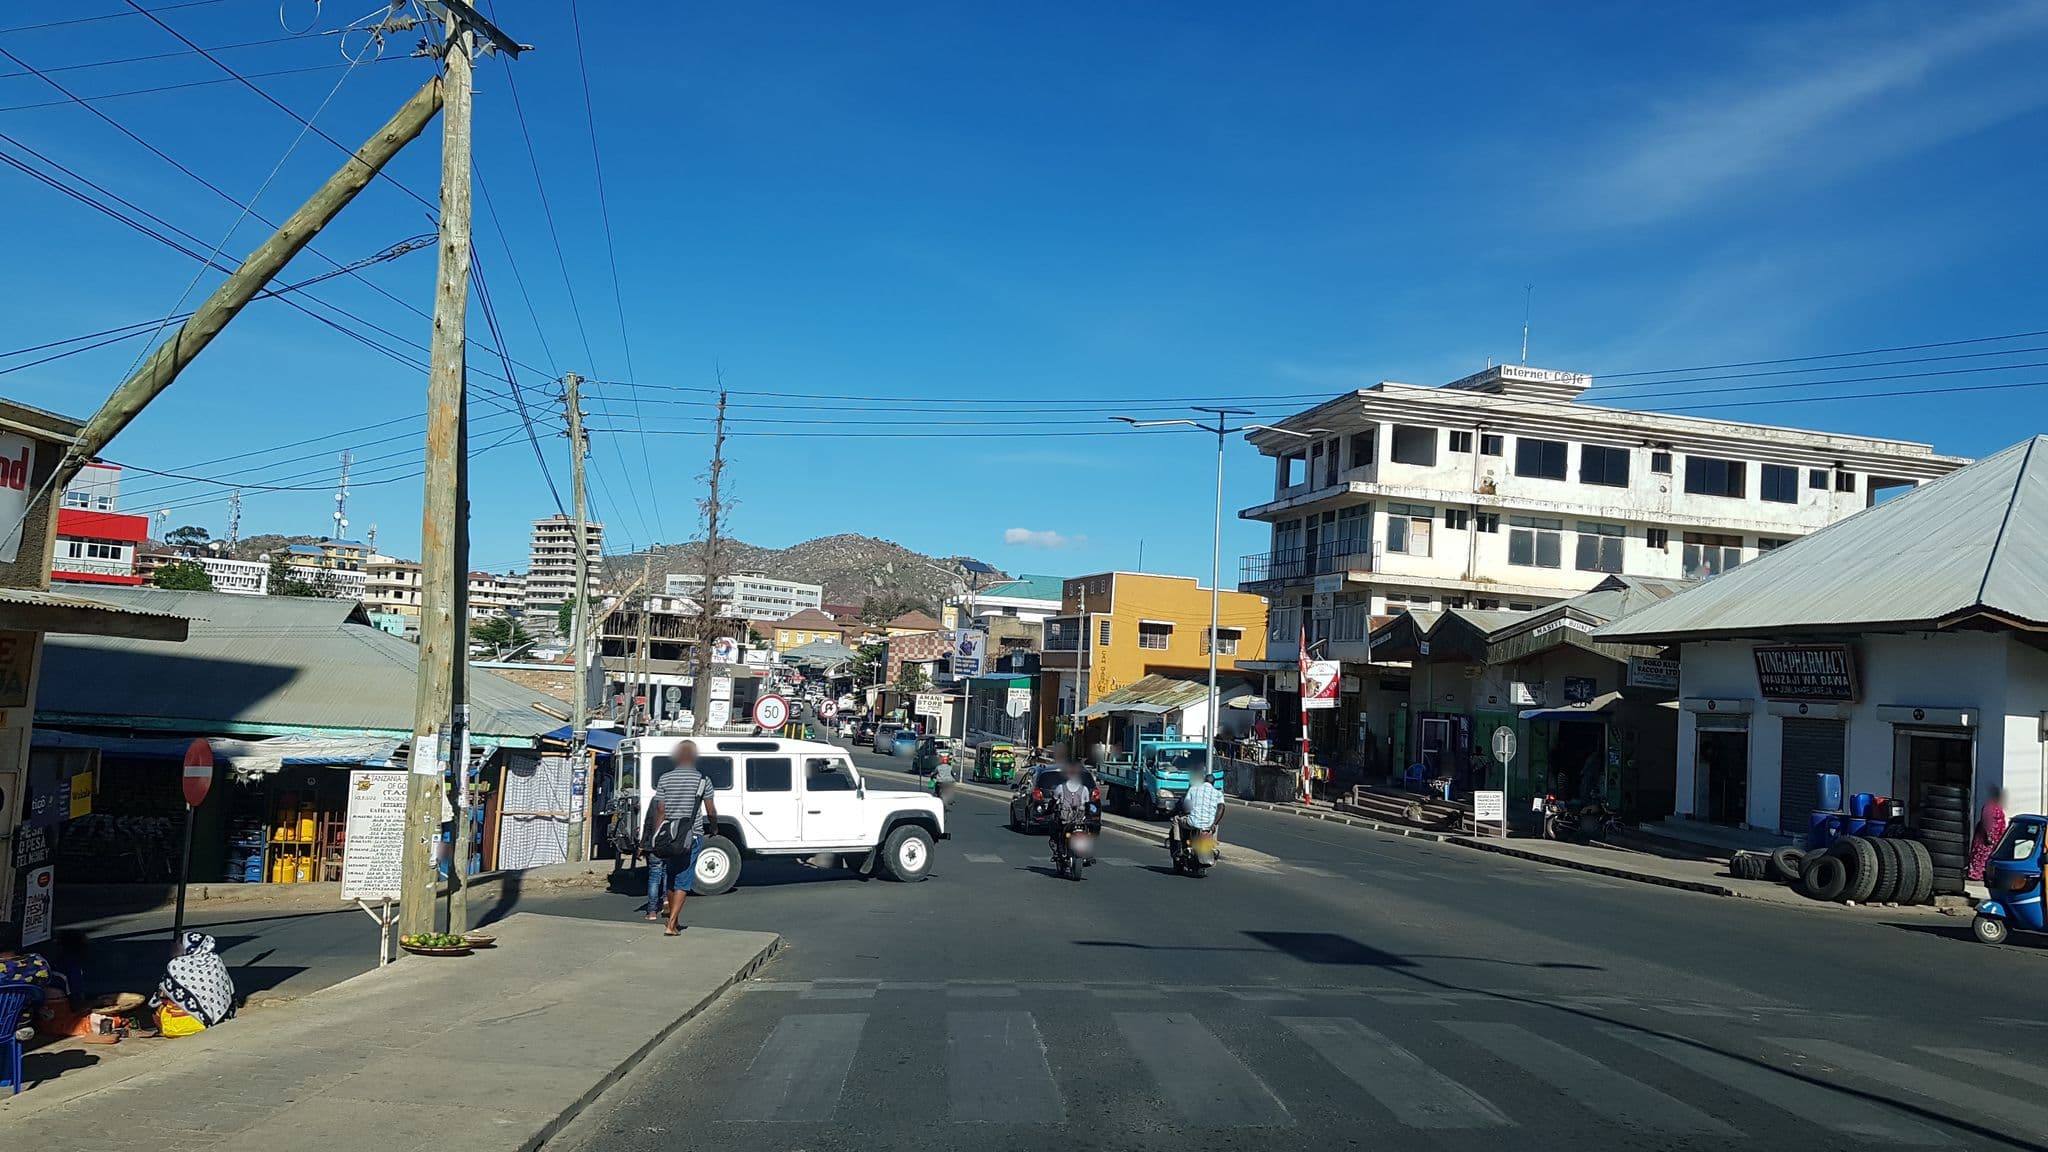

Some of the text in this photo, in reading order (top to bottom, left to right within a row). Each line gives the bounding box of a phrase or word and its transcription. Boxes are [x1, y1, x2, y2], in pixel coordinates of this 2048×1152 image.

[1503, 365, 1550, 379] Internet
[1761, 674, 1849, 687] WAUZAJI WA DAWA
[764, 705, 779, 719] 50
[370, 775, 402, 783] TANZANIA
